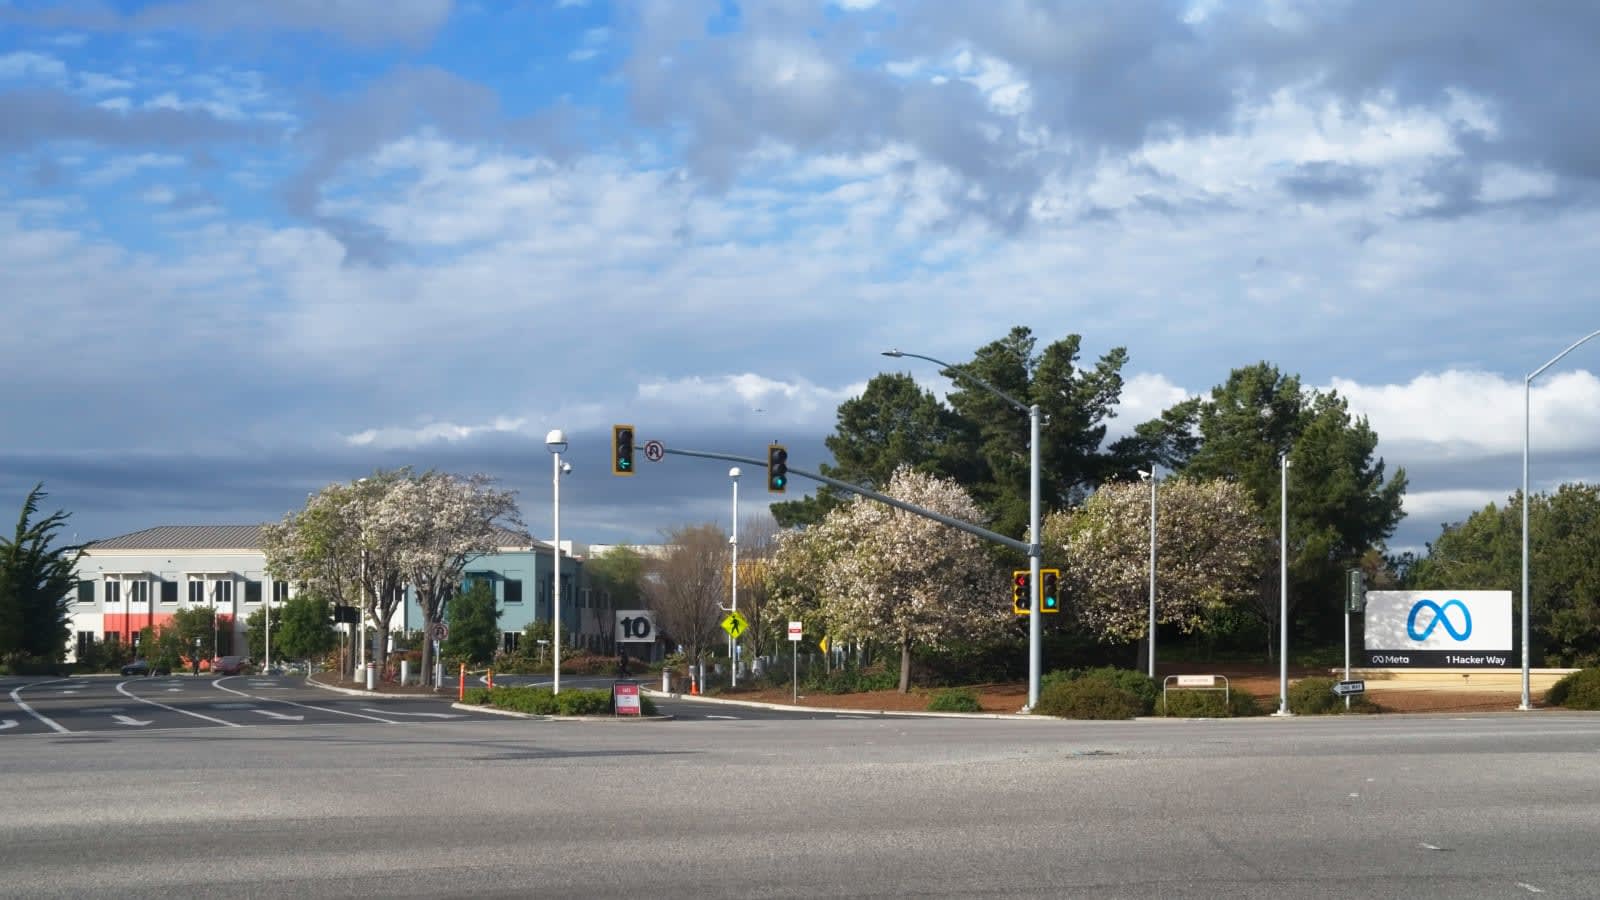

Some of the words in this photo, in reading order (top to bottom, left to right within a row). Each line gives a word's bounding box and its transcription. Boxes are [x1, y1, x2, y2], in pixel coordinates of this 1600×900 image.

[621, 616, 651, 638] 10
[1385, 655, 1409, 664] Meta
[1445, 655, 1450, 664] 1
[1452, 655, 1484, 664] Hacker
[1485, 655, 1506, 666] Way
